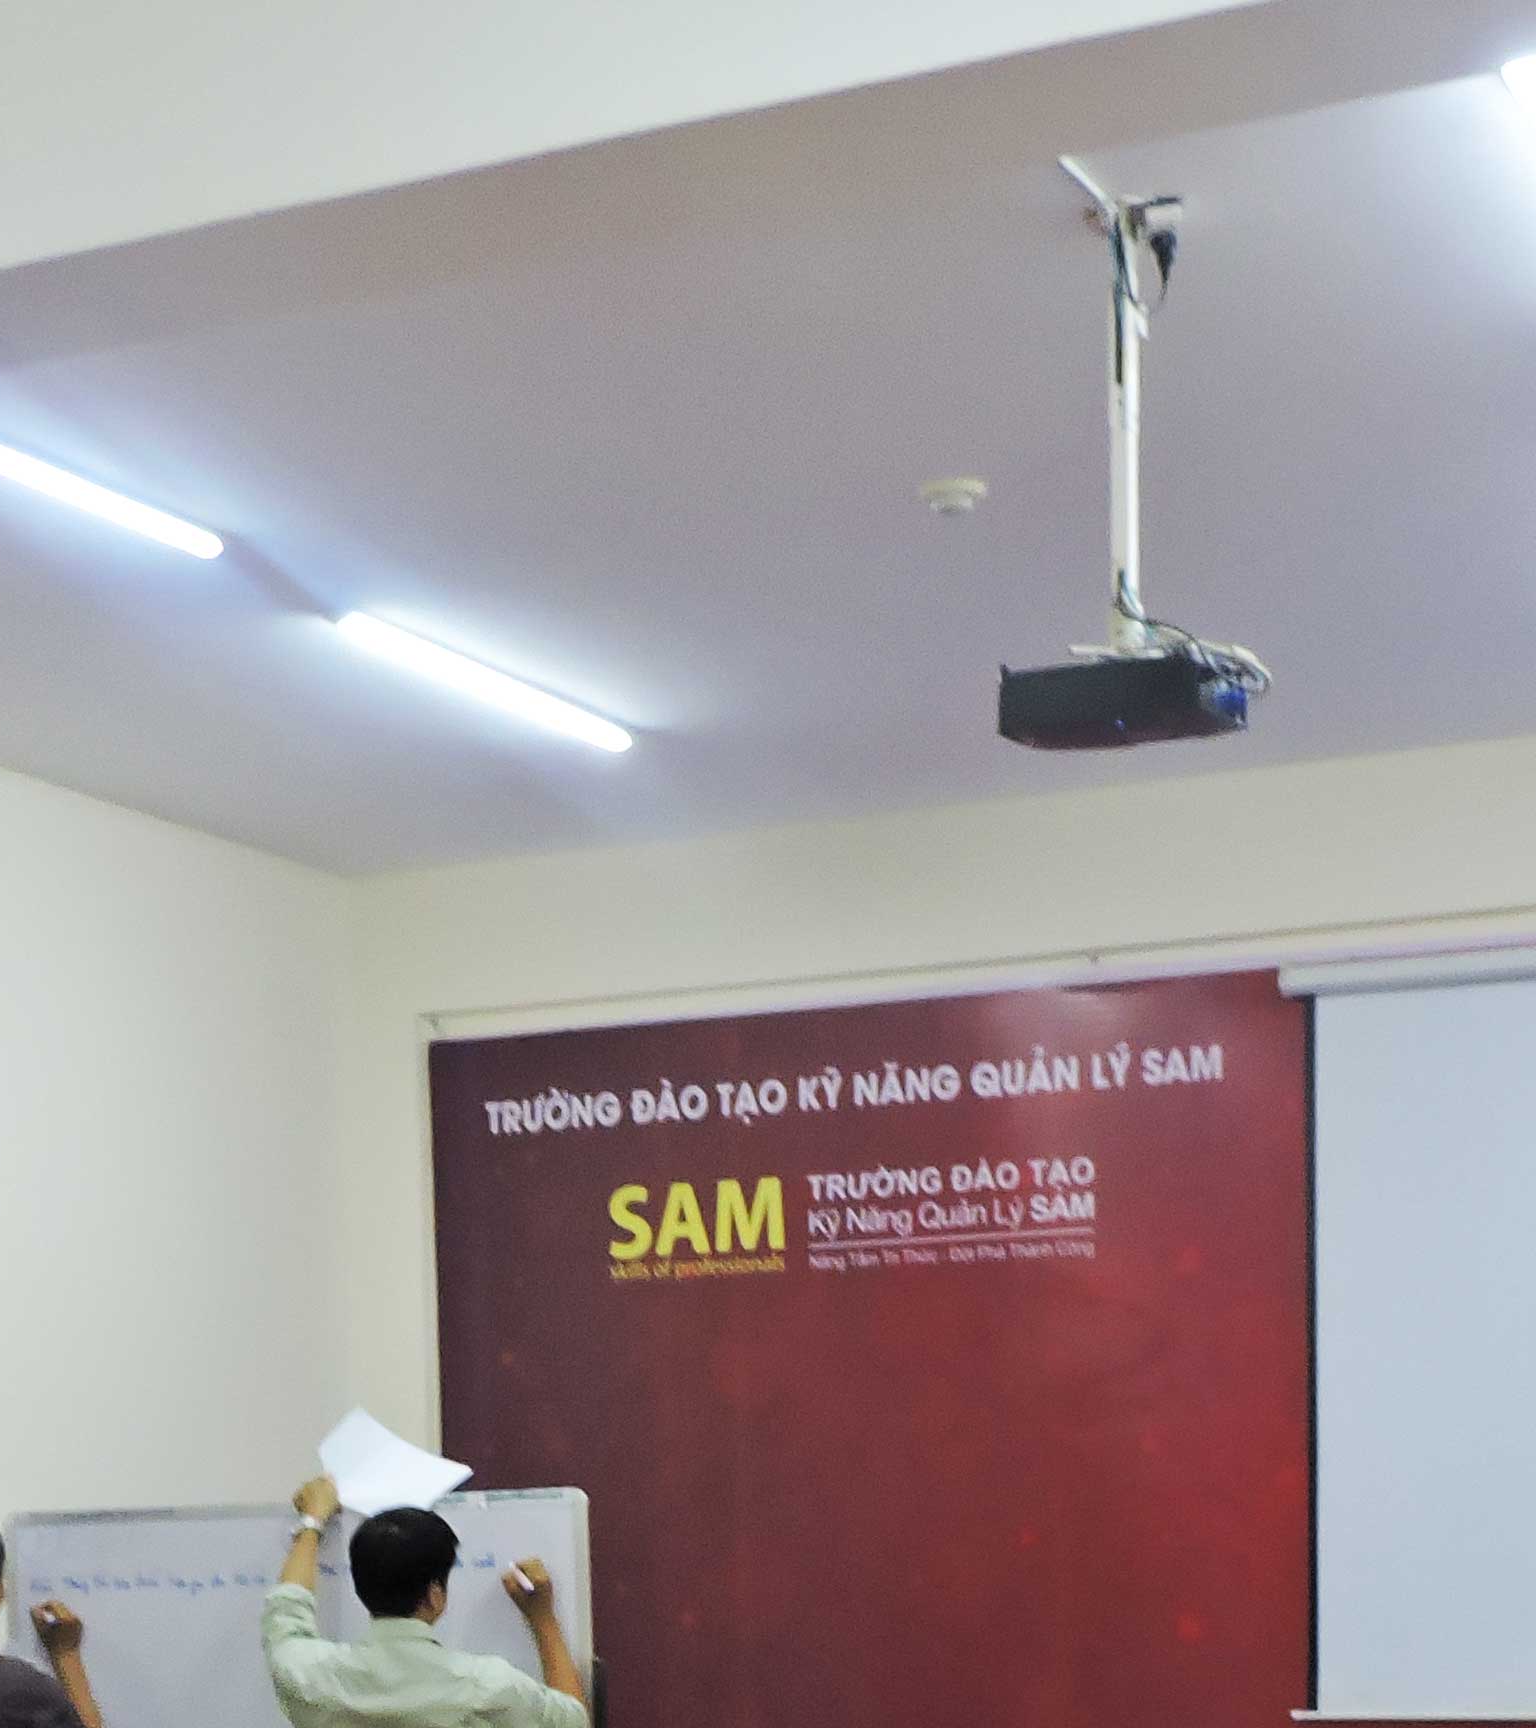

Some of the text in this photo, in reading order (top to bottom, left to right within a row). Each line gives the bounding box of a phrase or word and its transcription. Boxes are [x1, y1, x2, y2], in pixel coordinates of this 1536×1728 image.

[485, 1086, 621, 1134] TRƯỜNG
[629, 1078, 709, 1125] ĐÀO
[716, 1078, 787, 1125] TẠO
[852, 1061, 961, 1107] NĂNG
[969, 1043, 1080, 1097] QUẢN
[1141, 1044, 1224, 1086] SAM
[807, 1165, 941, 1201] TRƯỜNG
[950, 1157, 1021, 1193] ĐÀO
[1029, 1190, 1095, 1222] SAM
[609, 1176, 785, 1260] SAM
